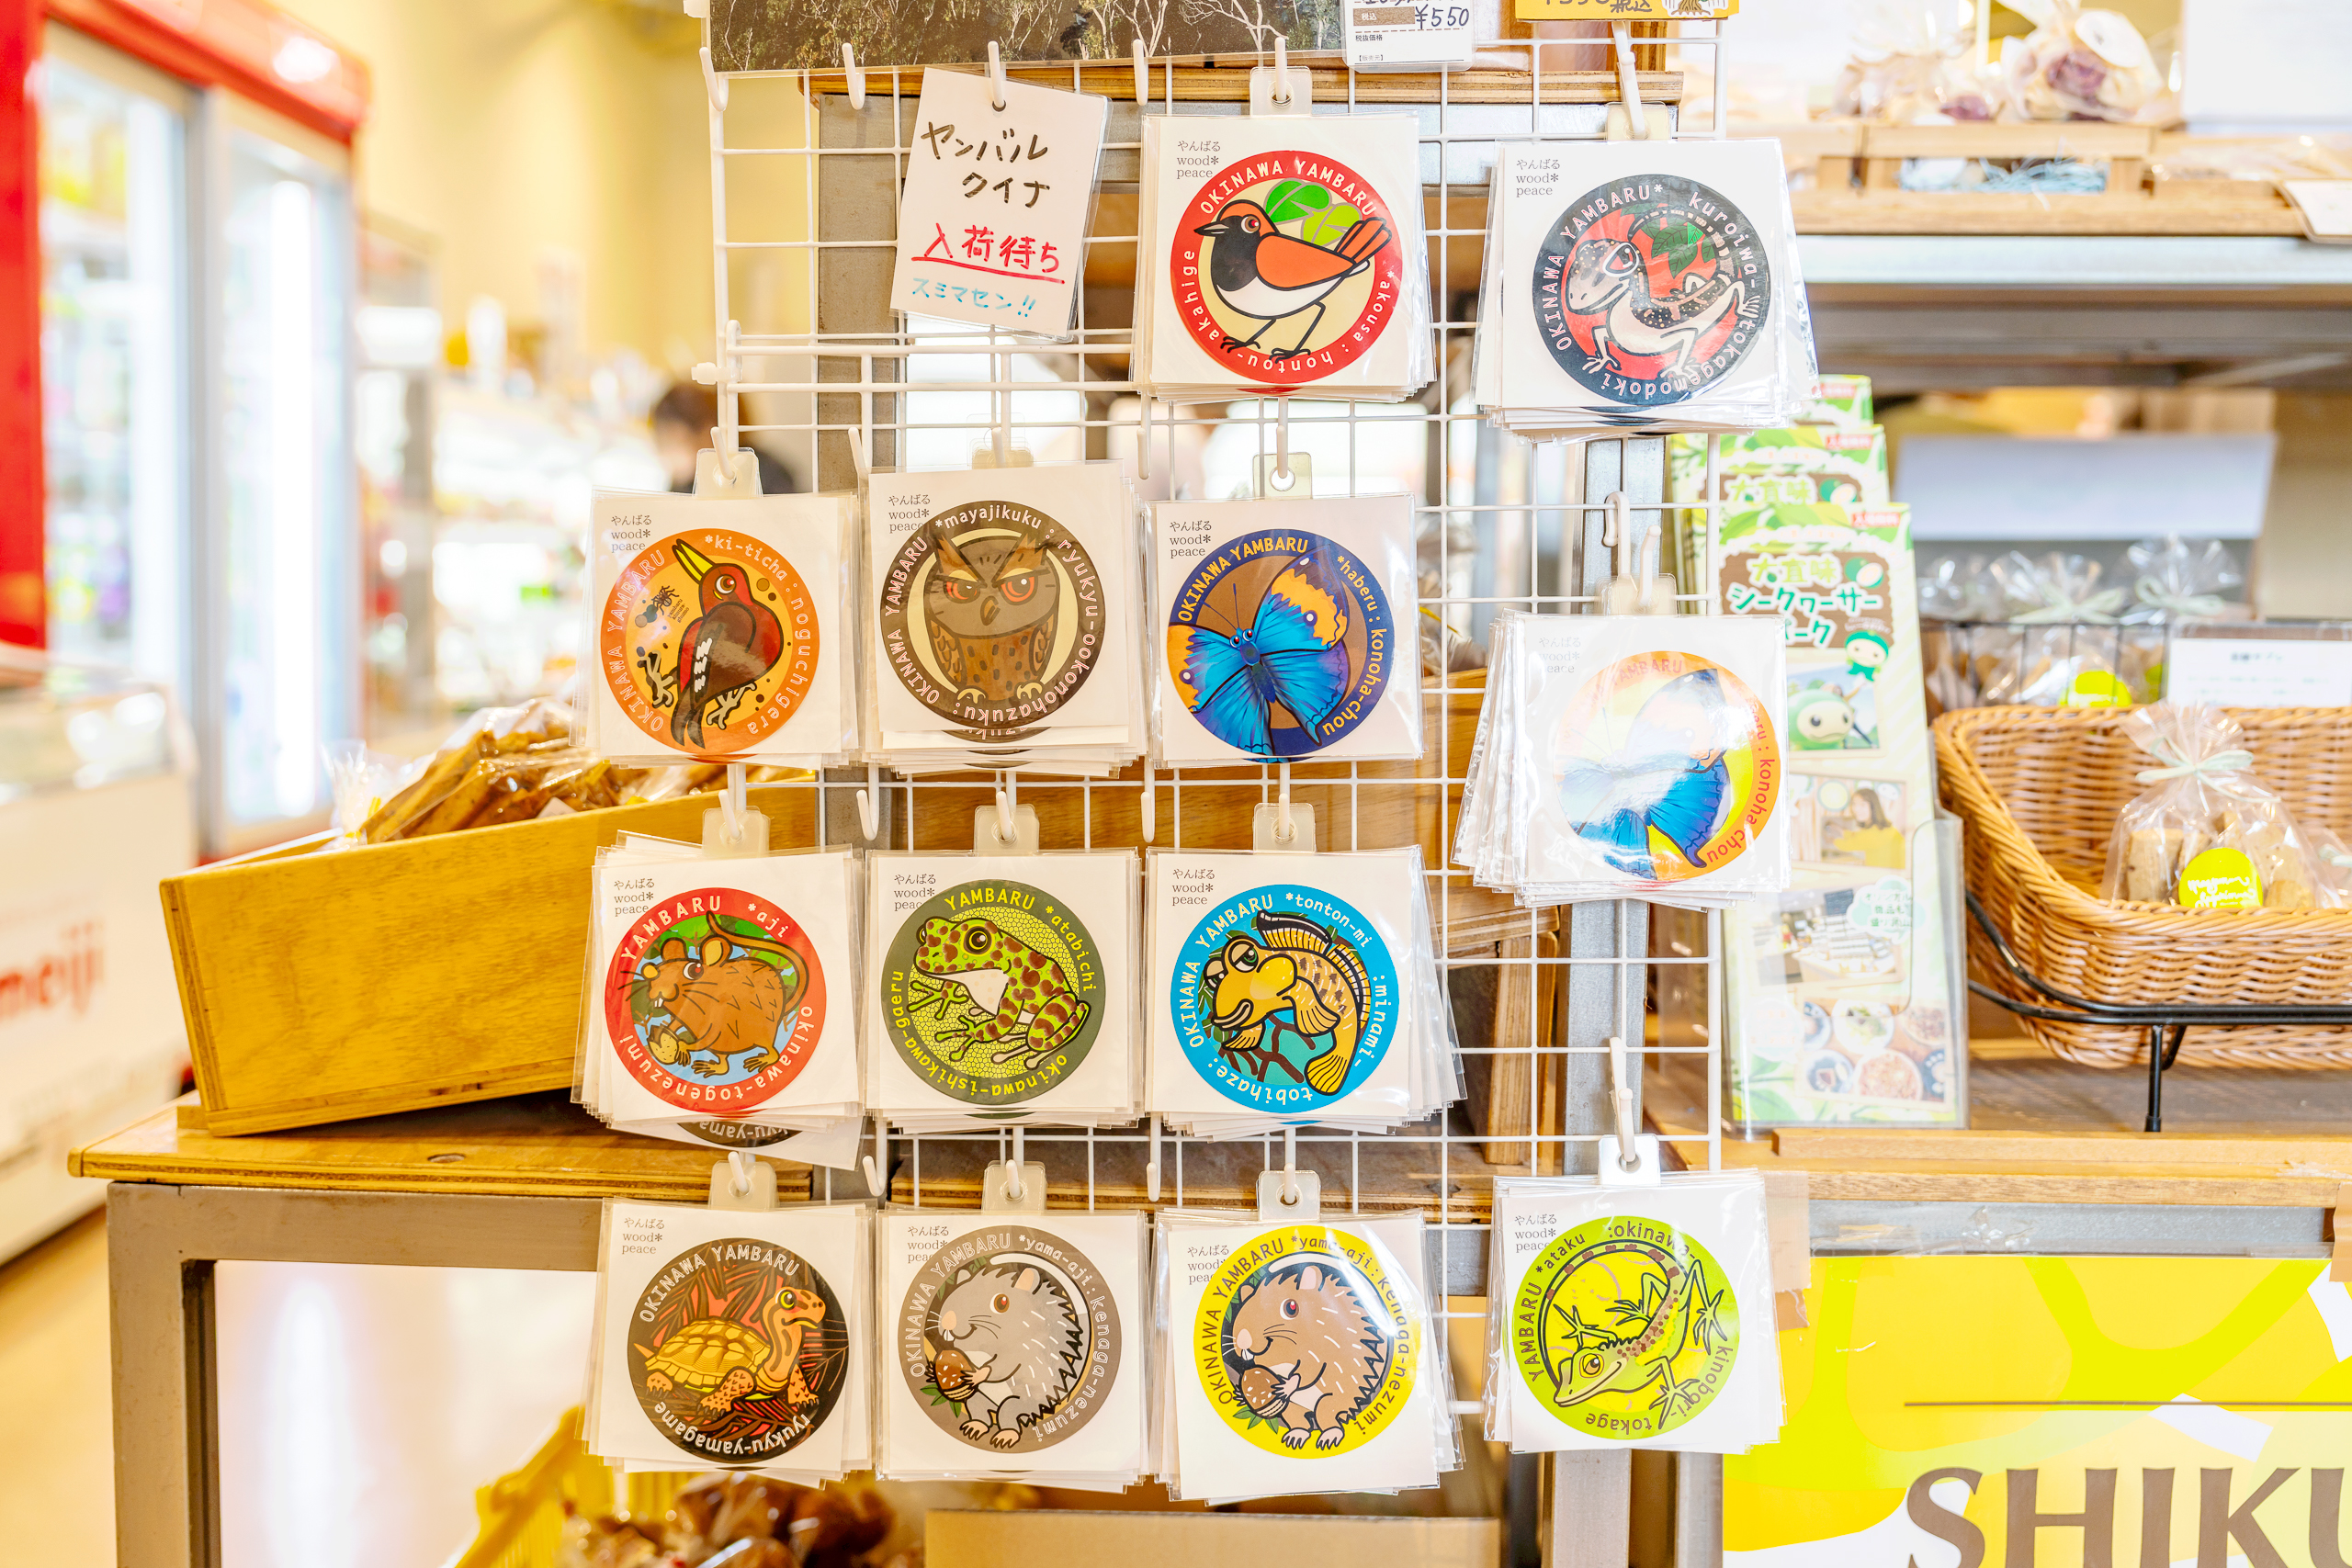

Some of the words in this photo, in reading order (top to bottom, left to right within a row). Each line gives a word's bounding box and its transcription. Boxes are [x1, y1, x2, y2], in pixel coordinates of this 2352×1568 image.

[1361, 12, 1377, 21] 税込
[1415, 4, 1470, 30] ¥550
[921, 121, 1048, 163] ヤンバル
[1177, 141, 1221, 152] やんばる
[1177, 168, 1213, 179] peace
[1516, 159, 1560, 170] やんばる
[962, 172, 1050, 208] クイナ
[1200, 160, 1283, 215] OKINAWA
[1296, 160, 1376, 216] YAMBARU
[1516, 186, 1553, 196] peace
[923, 223, 1059, 273] 入荷待ち
[1544, 255, 1572, 350] OKINAWA
[888, 494, 930, 506] やんばる
[611, 515, 652, 526] やんばる
[1170, 521, 1212, 532] やんばる
[611, 543, 646, 553] peace
[1170, 547, 1205, 558] peace
[886, 536, 928, 616] YAMBARU
[608, 549, 665, 632] YAMBARU
[1178, 557, 1231, 622] OKINAWA
[1230, 536, 1309, 561] YAMBARU
[1323, 628, 1387, 736] konoha-chou
[748, 598, 810, 734] noguchigera
[888, 629, 940, 705] OKINAWA
[1547, 665, 1575, 673] eace
[608, 645, 664, 732] OKINAWA
[614, 878, 654, 890] やんばる
[894, 874, 936, 885] やんばる
[1173, 869, 1215, 879] やんばる
[614, 905, 648, 917] peace
[894, 901, 922, 912] peac
[944, 887, 1035, 911] YAMBARU
[1172, 897, 1207, 906] peace
[621, 896, 721, 962] YAMBARU
[1180, 961, 1204, 1048] OKINAWA
[1195, 894, 1273, 950] YAMBARU
[891, 970, 1067, 1096] okinawa-ishikawa-gaeru
[619, 1006, 814, 1101] okinawa-togenezumi
[624, 1218, 665, 1229] やんばる
[908, 1226, 950, 1237] やんばる
[1515, 1214, 1557, 1225] やんばる
[621, 1245, 657, 1255] peace
[711, 1245, 800, 1276] YAMBARU
[908, 1253, 933, 1264] pea
[1187, 1246, 1229, 1257] やんばる
[1188, 1273, 1213, 1285] pea
[1213, 1237, 1284, 1299] YAMBARU
[639, 1253, 707, 1323] OKINAWA
[906, 1282, 936, 1377] OKINAWA
[931, 1233, 1011, 1279] YAMBARU
[1519, 1281, 1543, 1382] YAMBARU
[1202, 1308, 1234, 1404] OKINAWA
[654, 1401, 811, 1455] ryukyu-yamagame
